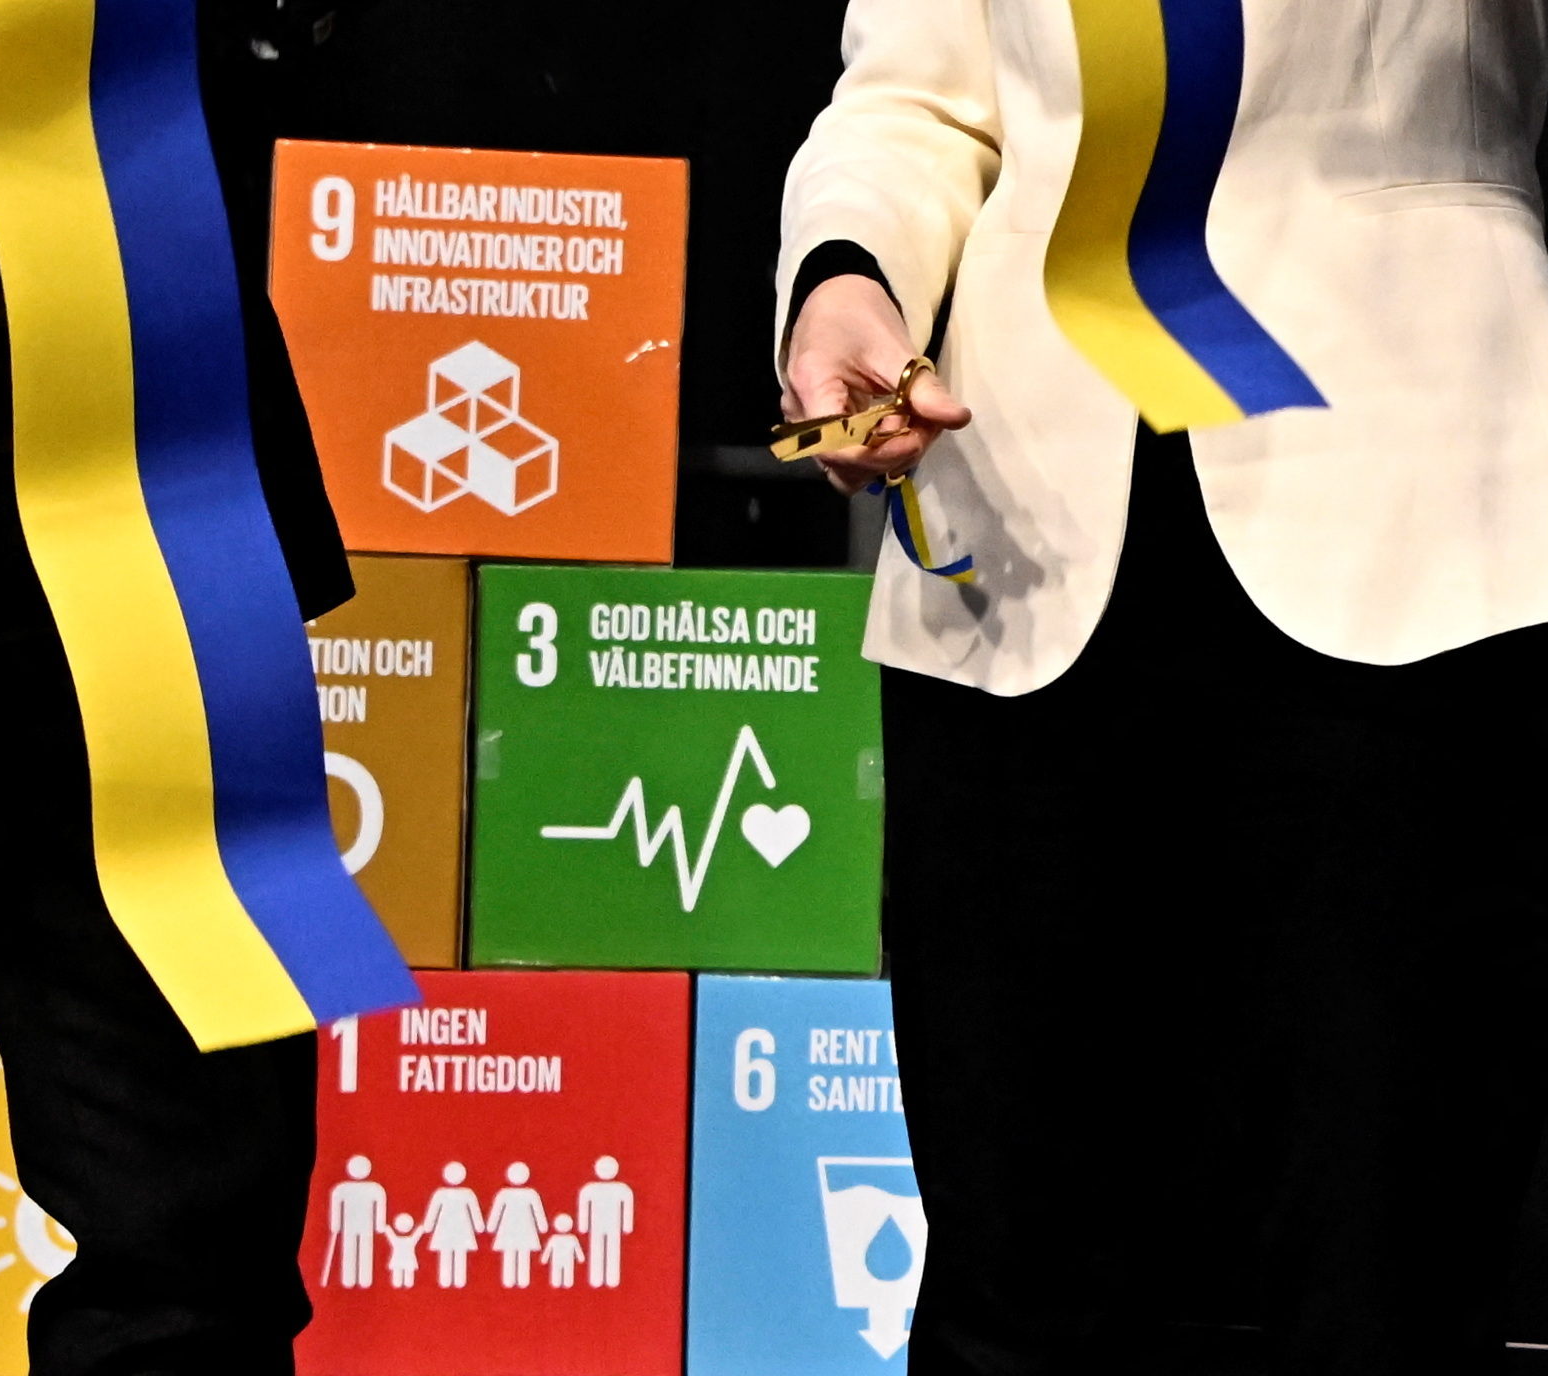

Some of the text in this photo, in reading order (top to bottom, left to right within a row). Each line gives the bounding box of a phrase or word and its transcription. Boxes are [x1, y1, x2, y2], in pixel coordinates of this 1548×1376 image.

[312, 176, 354, 261] 9
[375, 173, 627, 230] HÅLLBAR INDUSTRI,
[373, 228, 624, 275] INNOVATIONER OCH
[371, 274, 589, 320] INFRASTRUKTUR
[517, 602, 558, 687] 3
[591, 600, 816, 645] GOD HÄLSA OCH
[375, 639, 433, 677] OCH
[589, 646, 819, 692] VÄLBEFINNANDE
[316, 685, 367, 722] ION
[401, 1008, 487, 1045] INGEN
[810, 1029, 882, 1065] RENT
[331, 1013, 359, 1093] 1
[400, 1055, 561, 1093] FATTIGDOM
[735, 1028, 776, 1112] 6
